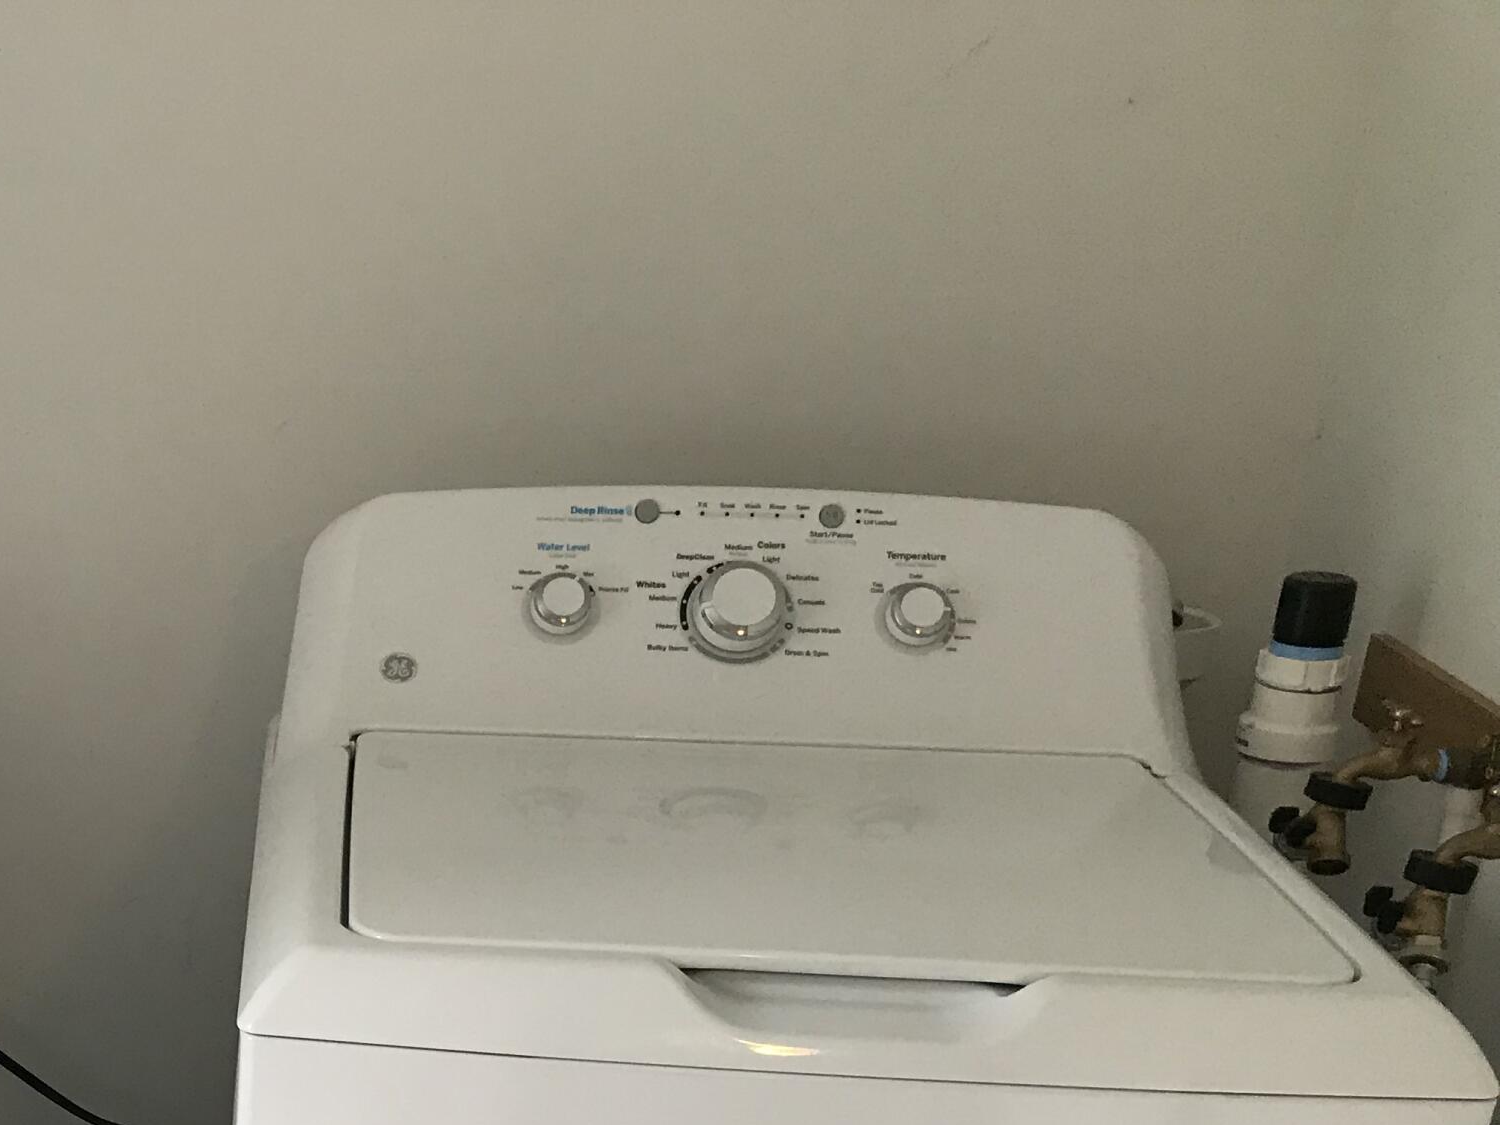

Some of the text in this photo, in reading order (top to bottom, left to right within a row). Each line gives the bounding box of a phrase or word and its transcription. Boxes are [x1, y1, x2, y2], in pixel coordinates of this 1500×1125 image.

[570, 506, 596, 516] Deep
[597, 506, 625, 515] Rinse
[537, 543, 591, 552] Water Level
[724, 543, 754, 551] Medium
[757, 540, 786, 550] Colors
[676, 553, 715, 561] DeepClean
[762, 555, 781, 564] Light
[886, 551, 947, 562] Temperature
[672, 571, 690, 579] Light
[636, 580, 667, 588] Whites
[655, 623, 678, 631] Heavy
[797, 626, 820, 634] Speed
[647, 644, 667, 652] Bulky
